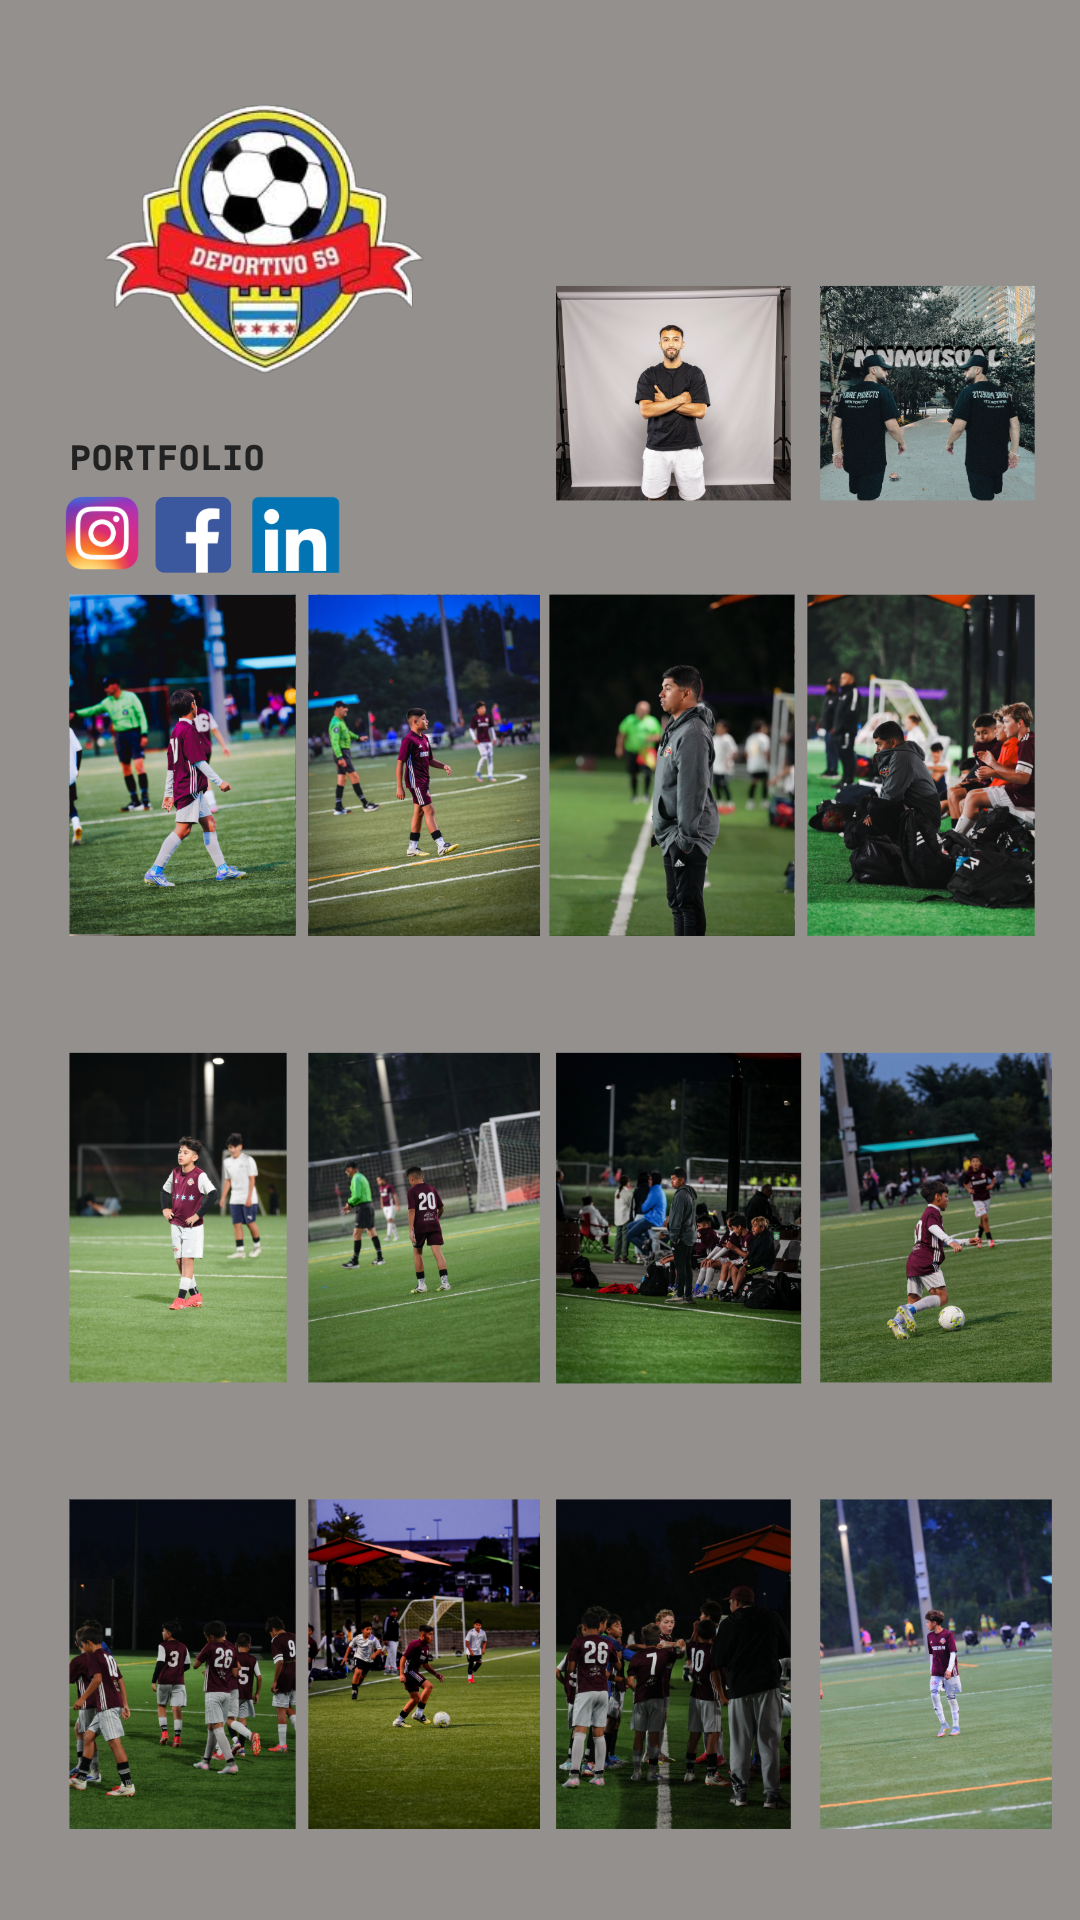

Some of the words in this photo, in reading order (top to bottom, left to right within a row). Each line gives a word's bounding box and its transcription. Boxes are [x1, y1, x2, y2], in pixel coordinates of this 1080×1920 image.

[418, 1192, 436, 1210] 20
[168, 1651, 179, 1667] 3
[214, 1647, 233, 1668] 26
[288, 1640, 296, 1657] 9
[584, 1640, 609, 1664] 26
[103, 1653, 119, 1677] 10
[646, 1652, 657, 1675] 7
[691, 1648, 704, 1672] 10
[238, 1666, 250, 1685] 5
